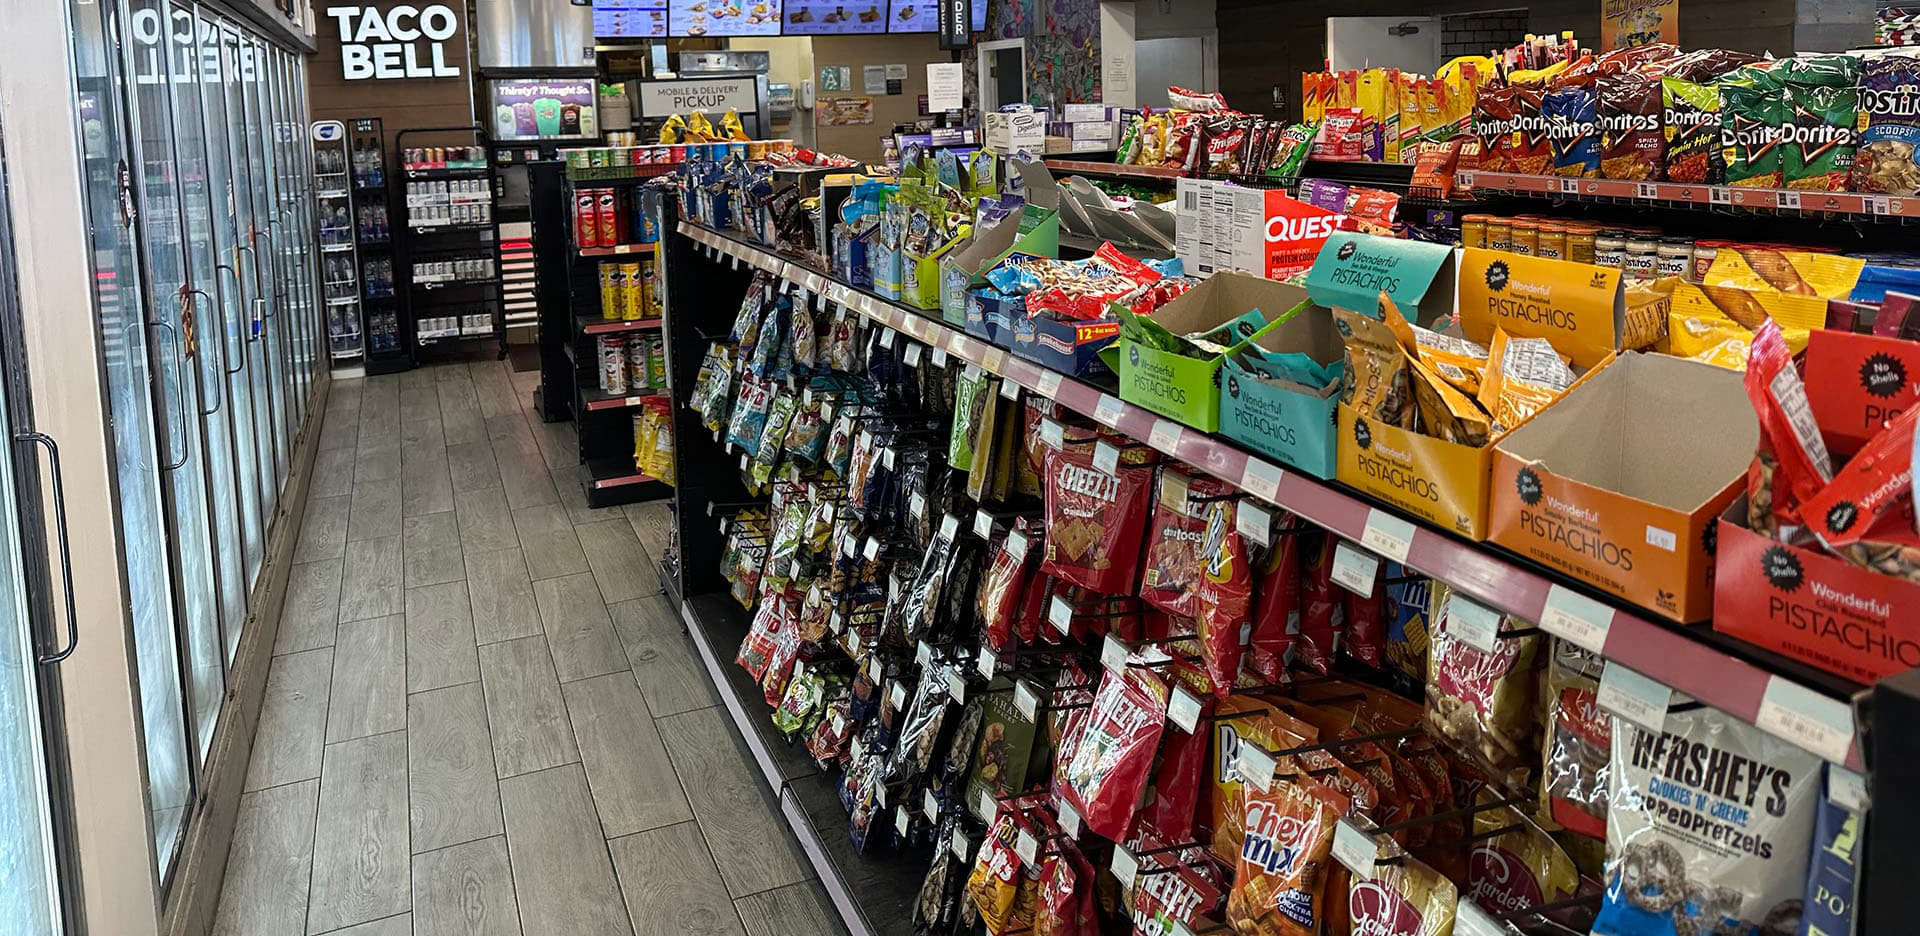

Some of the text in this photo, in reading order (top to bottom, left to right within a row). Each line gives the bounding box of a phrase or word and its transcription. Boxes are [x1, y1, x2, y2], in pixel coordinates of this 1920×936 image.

[327, 4, 457, 42] TACO
[342, 43, 460, 80] BELL
[499, 86, 590, 97] Thirsty? Thought So.
[658, 85, 739, 96] MOBILE & DELIVERY
[1858, 85, 1920, 116] TOSTIT
[674, 95, 725, 109] PICKUP
[1513, 114, 1544, 131] Dori
[1665, 109, 1723, 127] Doritos
[1721, 126, 1782, 146] Dorit
[1875, 126, 1914, 137] SCOOPS!
[1265, 214, 1350, 243] QUEST
[1272, 253, 1297, 265] PROTEIN
[1353, 251, 1400, 268] Wonderful
[1330, 267, 1400, 294] PISTACHIOS
[1493, 266, 1502, 274] No
[1510, 292, 1527, 302] Honey
[1511, 279, 1551, 296] Wonderful
[1489, 296, 1577, 332] PISTACHIOS
[1140, 359, 1175, 378] Wonderful
[1873, 363, 1890, 372] No
[1134, 374, 1187, 406] PISTACHIOS
[1869, 373, 1900, 386] Shells
[1240, 389, 1282, 415] Wonderful
[1234, 407, 1297, 446] PISTACHIOS
[1374, 441, 1413, 463] Wonderful
[1358, 454, 1440, 502] PISTACHIOS
[1860, 471, 1911, 510] Wonder
[1063, 507, 1095, 519] Original
[1547, 495, 1599, 523] Wonderful
[1177, 527, 1206, 543] toast
[1520, 509, 1633, 572] PISTACHIOS
[1773, 554, 1788, 566] No
[1770, 566, 1798, 578] Shells
[1811, 580, 1890, 618] Wonderful
[1769, 596, 1920, 669] PISTACHIO
[1632, 728, 1792, 818] HERSHEY'S
[1649, 776, 1693, 807] COOKIES
[1710, 800, 1750, 828] CREME
[1244, 800, 1309, 847] Chex
[1242, 833, 1304, 877] mix
[1286, 888, 1312, 902] NOW
